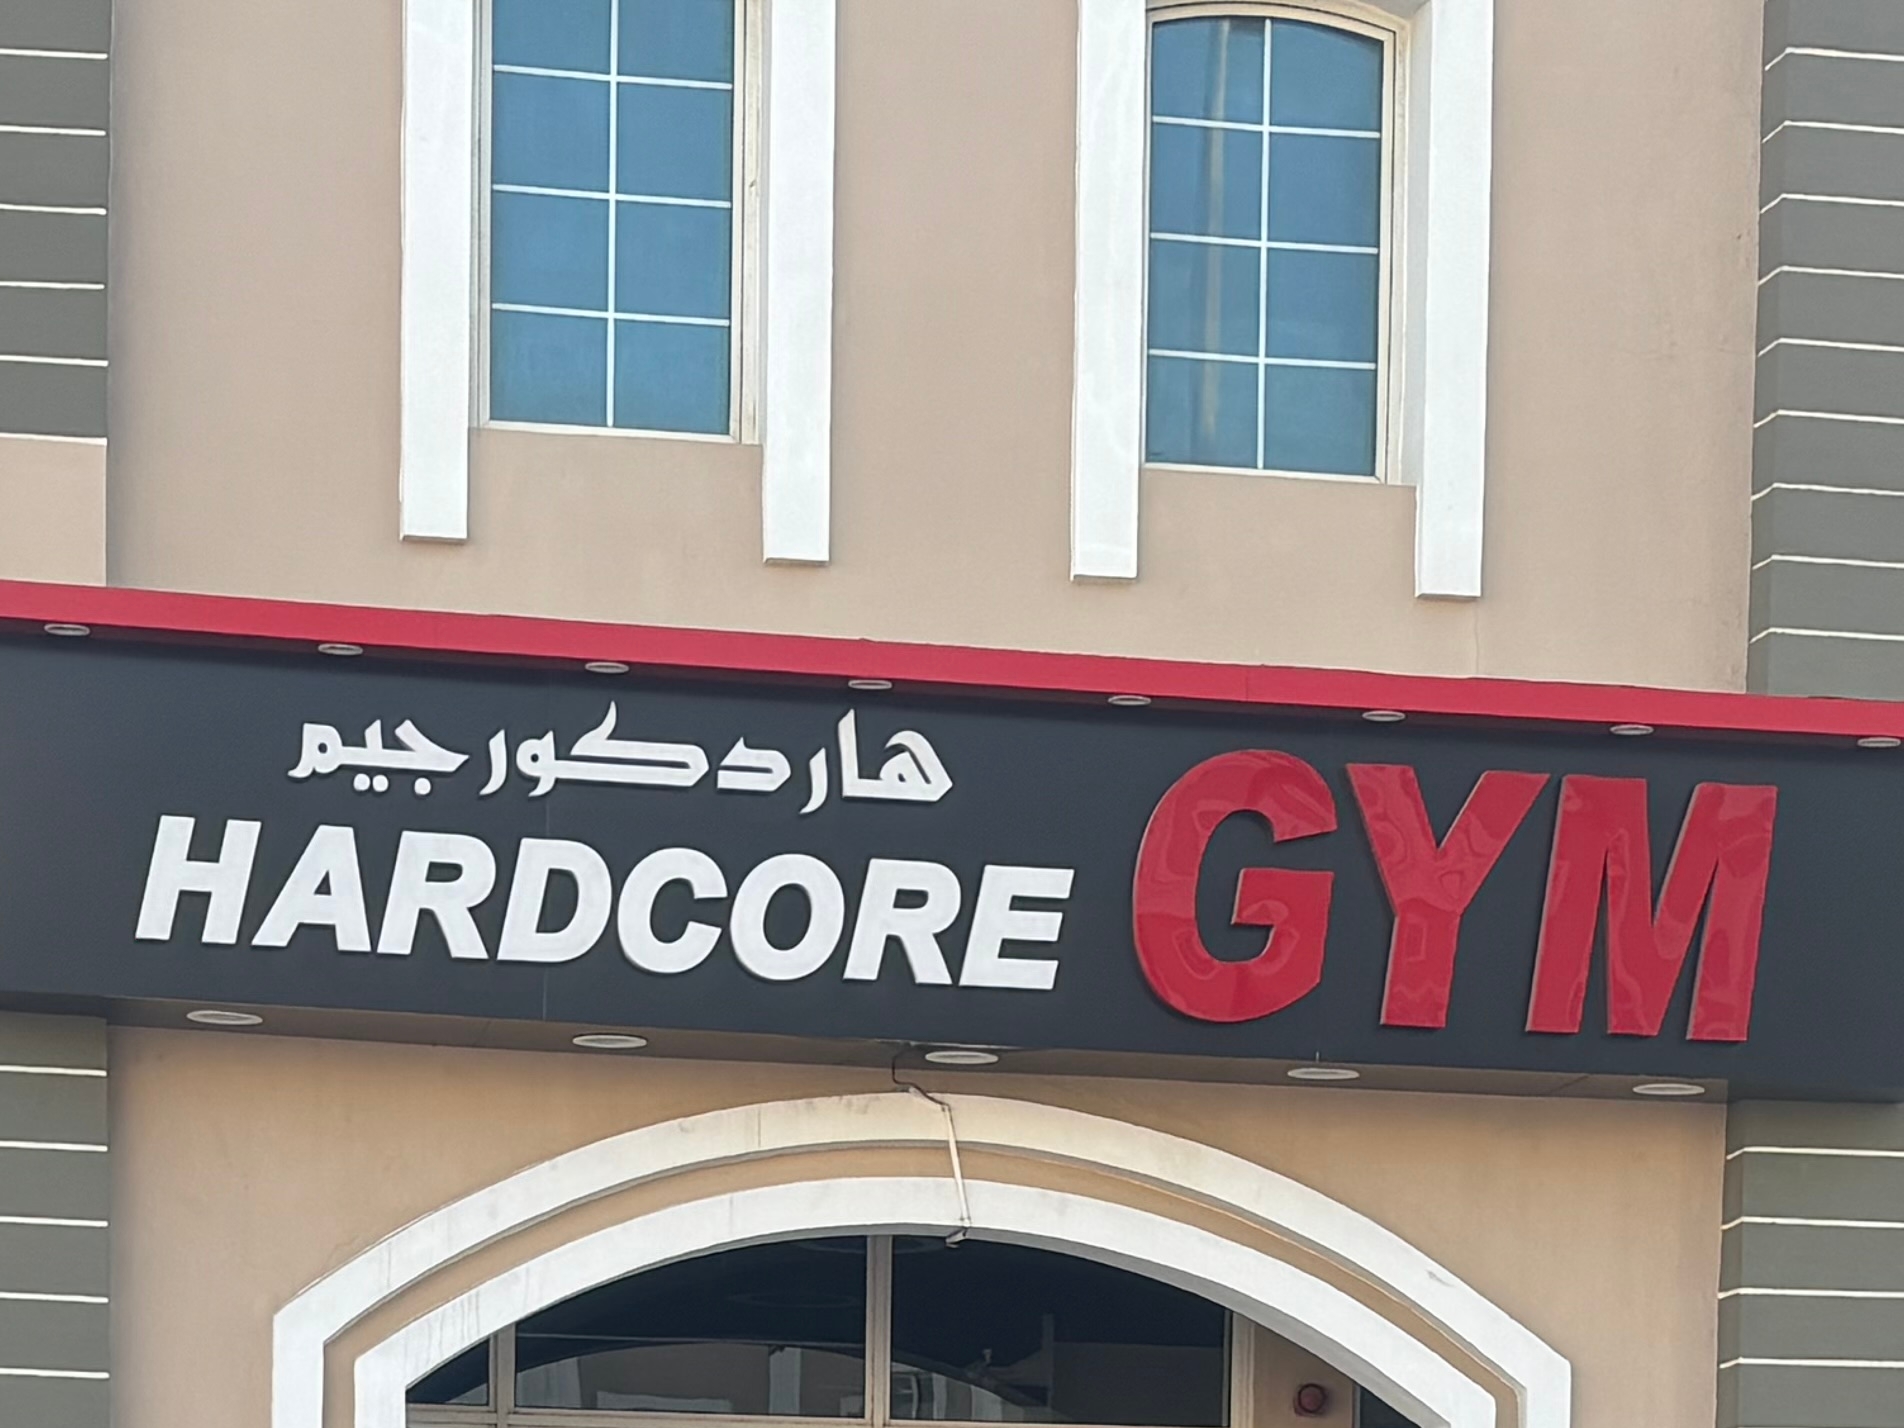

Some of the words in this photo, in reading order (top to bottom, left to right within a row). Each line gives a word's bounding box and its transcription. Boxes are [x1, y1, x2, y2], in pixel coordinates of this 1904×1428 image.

[287, 718, 470, 795] جيم
[135, 814, 1075, 990] HARDCORE
[1132, 748, 1778, 1042] GYM
